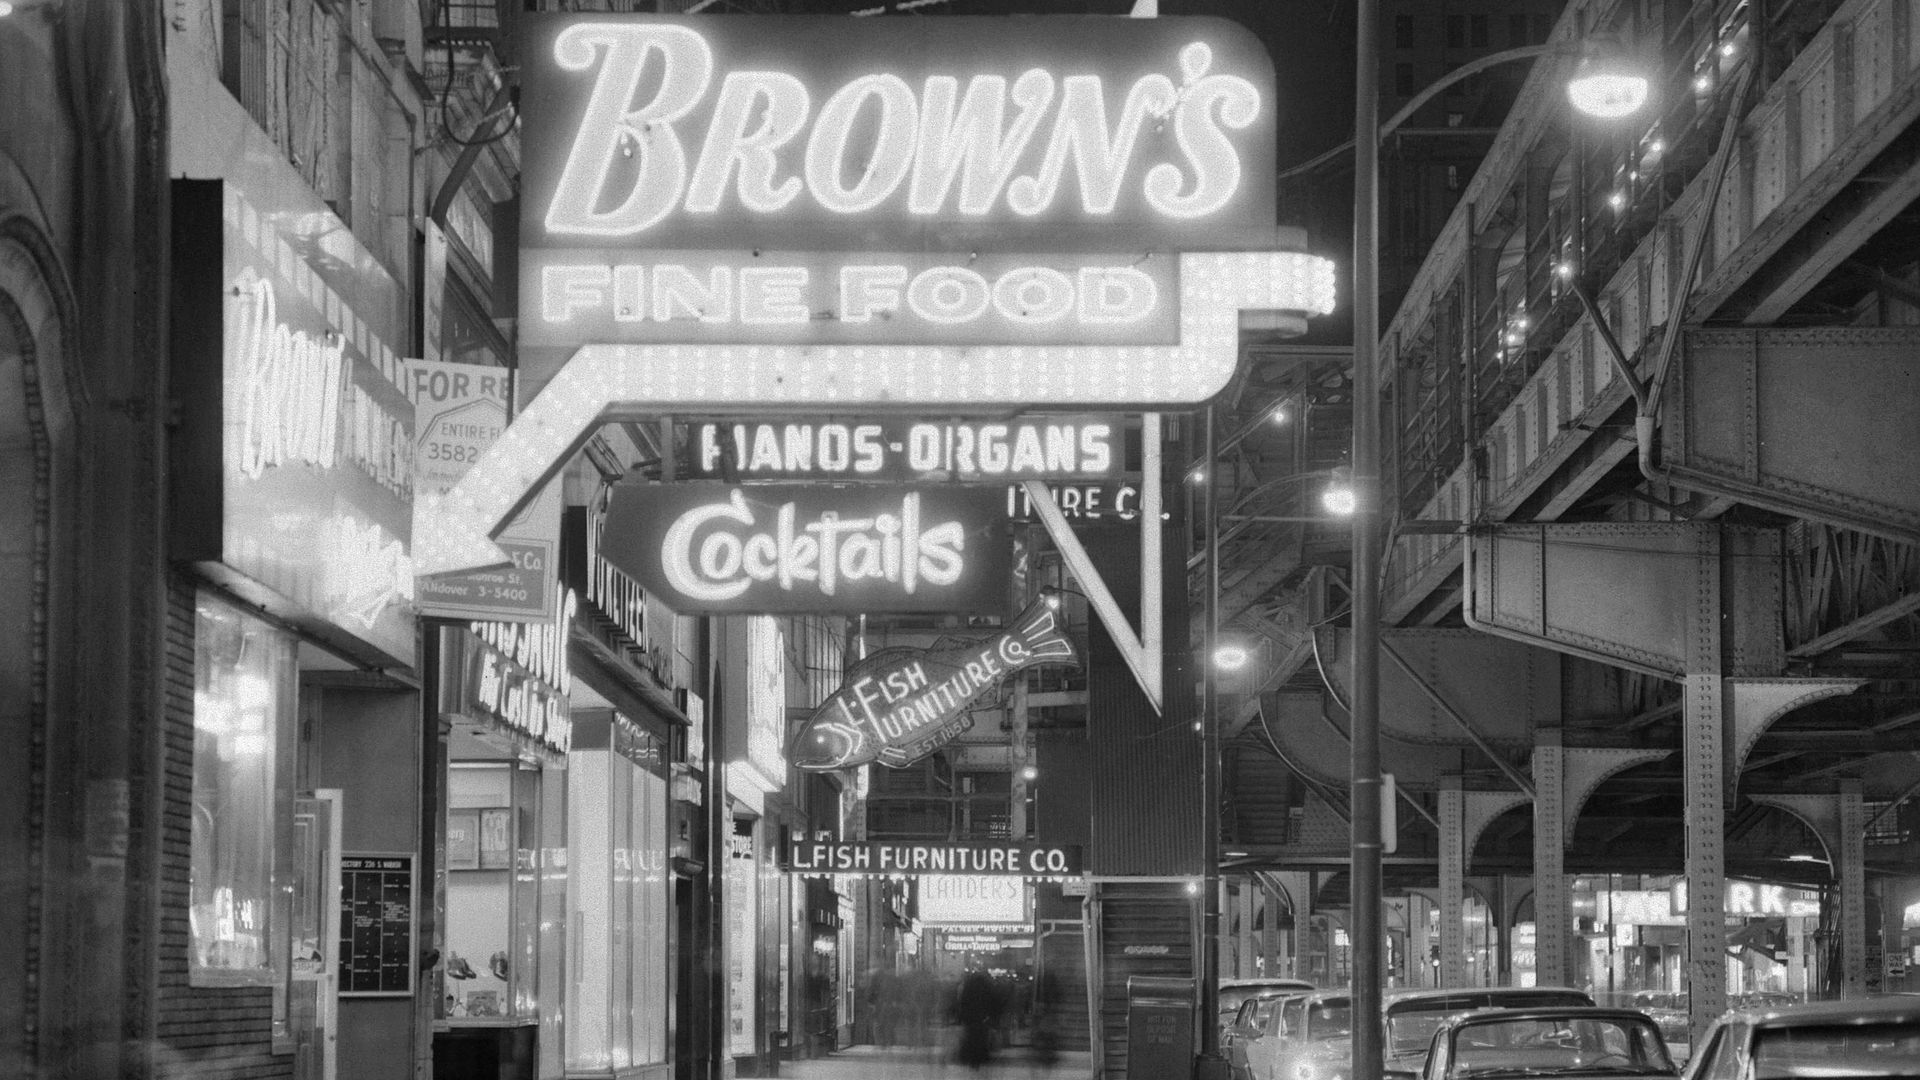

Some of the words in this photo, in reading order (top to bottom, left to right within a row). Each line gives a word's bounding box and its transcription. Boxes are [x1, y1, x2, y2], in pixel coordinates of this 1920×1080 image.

[544, 22, 1261, 236] BROWN'S
[541, 265, 810, 323] FINE
[839, 265, 1157, 324] FOOD
[413, 369, 469, 405] FOR
[442, 422, 486, 440] ENTIRE
[428, 442, 478, 464] 3582
[660, 488, 964, 601] Cocktails
[478, 586, 528, 600] 3-5400
[880, 847, 1021, 872] FURNITURE
[1030, 849, 1069, 873] CO.
